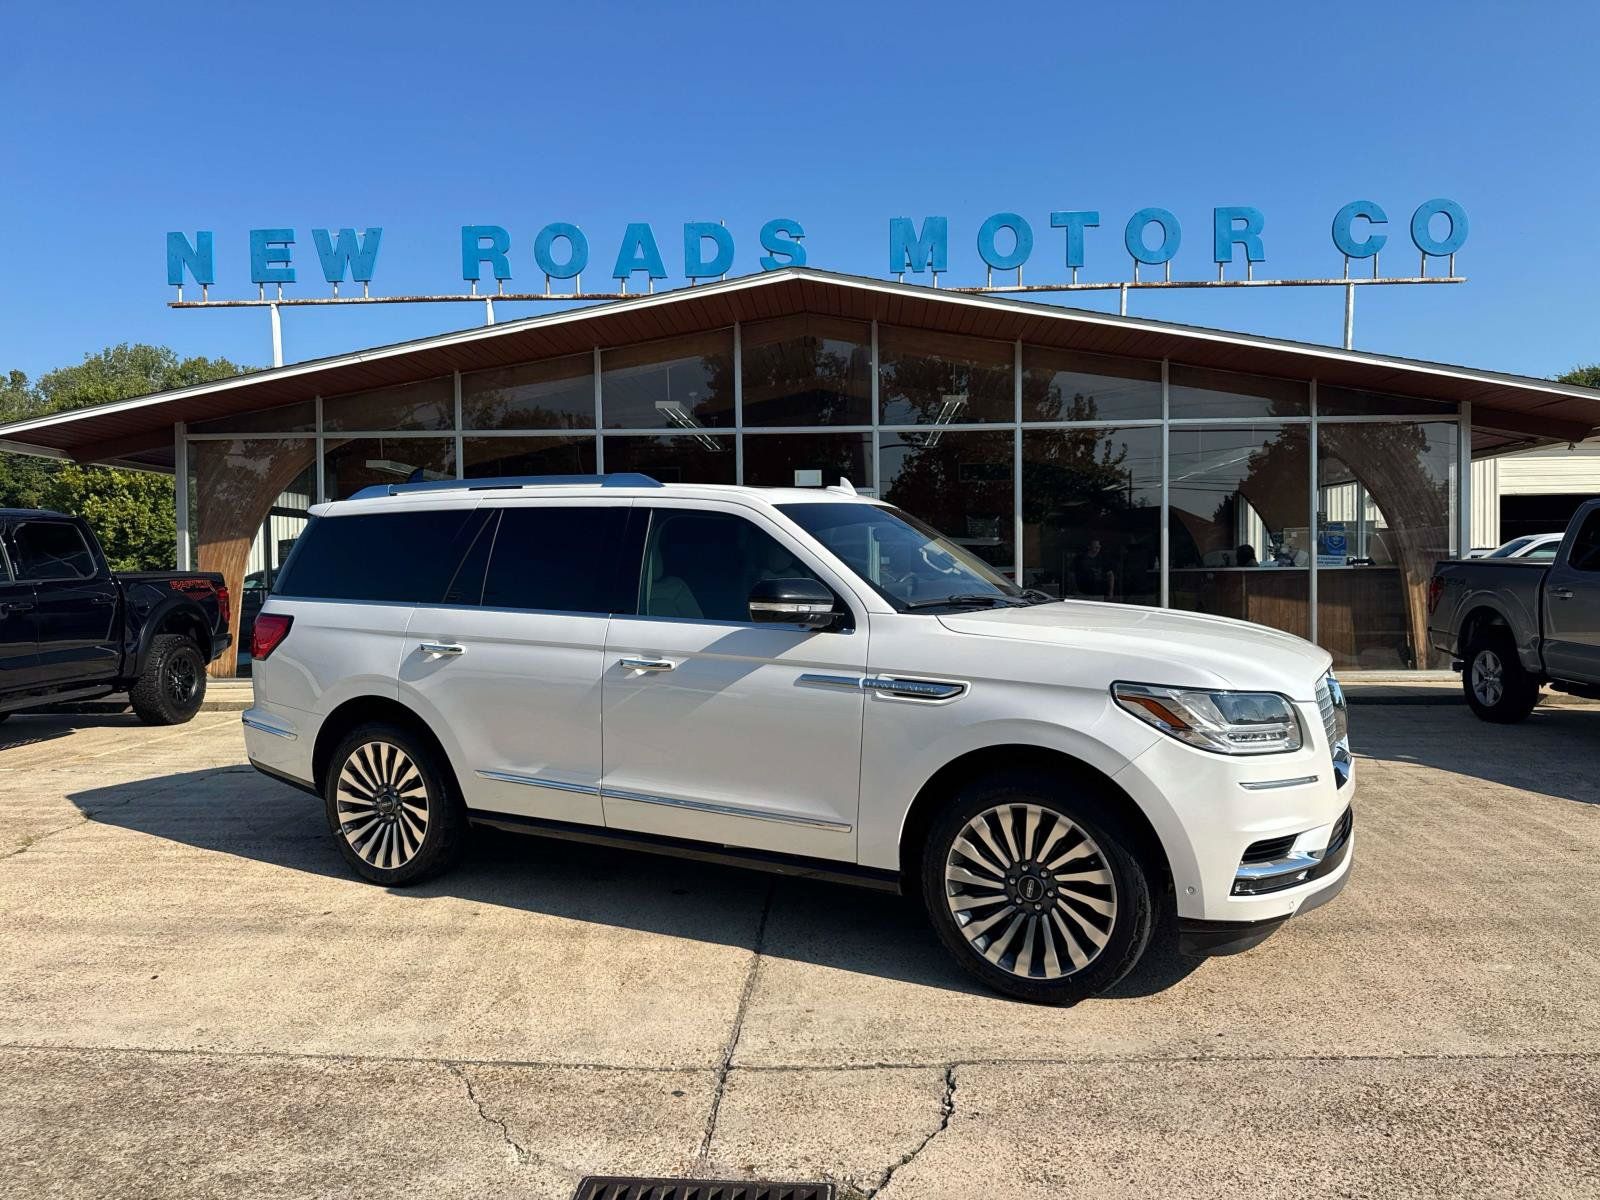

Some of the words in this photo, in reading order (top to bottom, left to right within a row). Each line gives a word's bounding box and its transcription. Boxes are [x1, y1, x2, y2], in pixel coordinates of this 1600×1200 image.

[167, 227, 382, 285] NEW
[462, 218, 807, 280] ROADS
[890, 206, 1265, 273] MOTOR
[1332, 198, 1469, 258] CO
